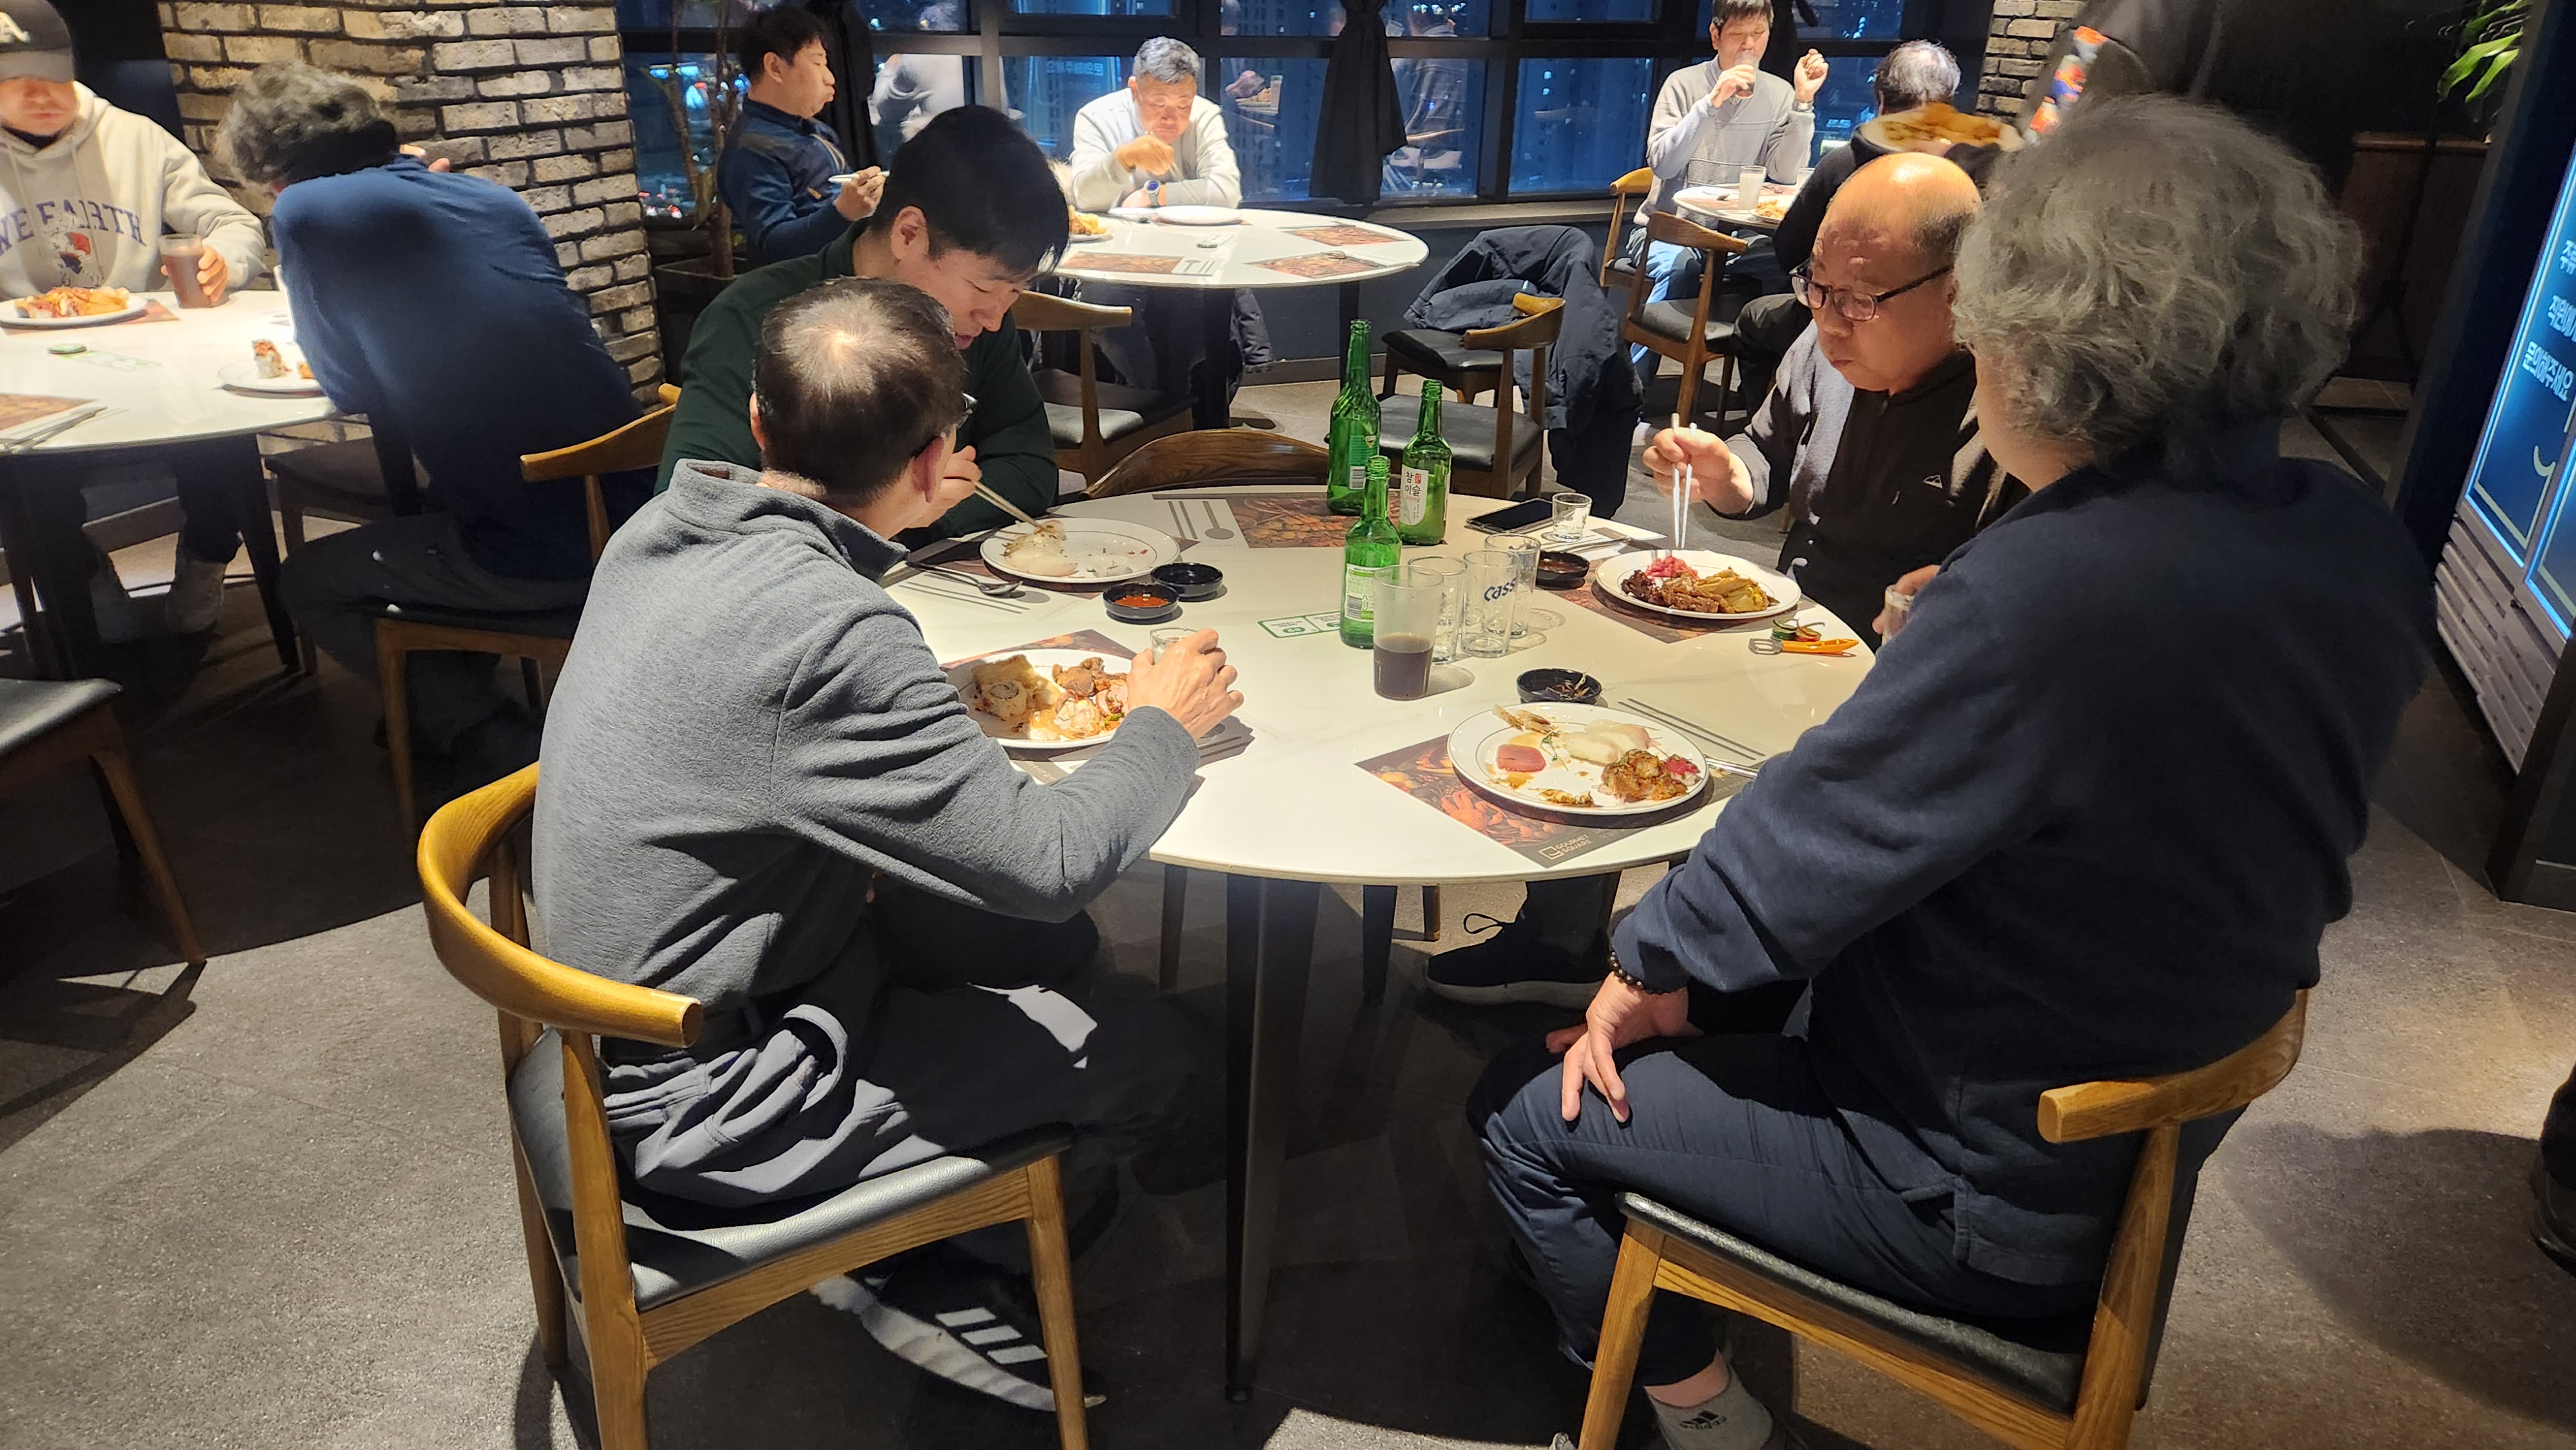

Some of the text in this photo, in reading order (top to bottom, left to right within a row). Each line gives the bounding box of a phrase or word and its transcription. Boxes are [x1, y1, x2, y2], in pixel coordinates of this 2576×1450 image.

[2523, 341, 2574, 402] 문의해주세요
[1555, 834, 1589, 849] GOURMET
[1561, 839, 1593, 853] SQUARE
